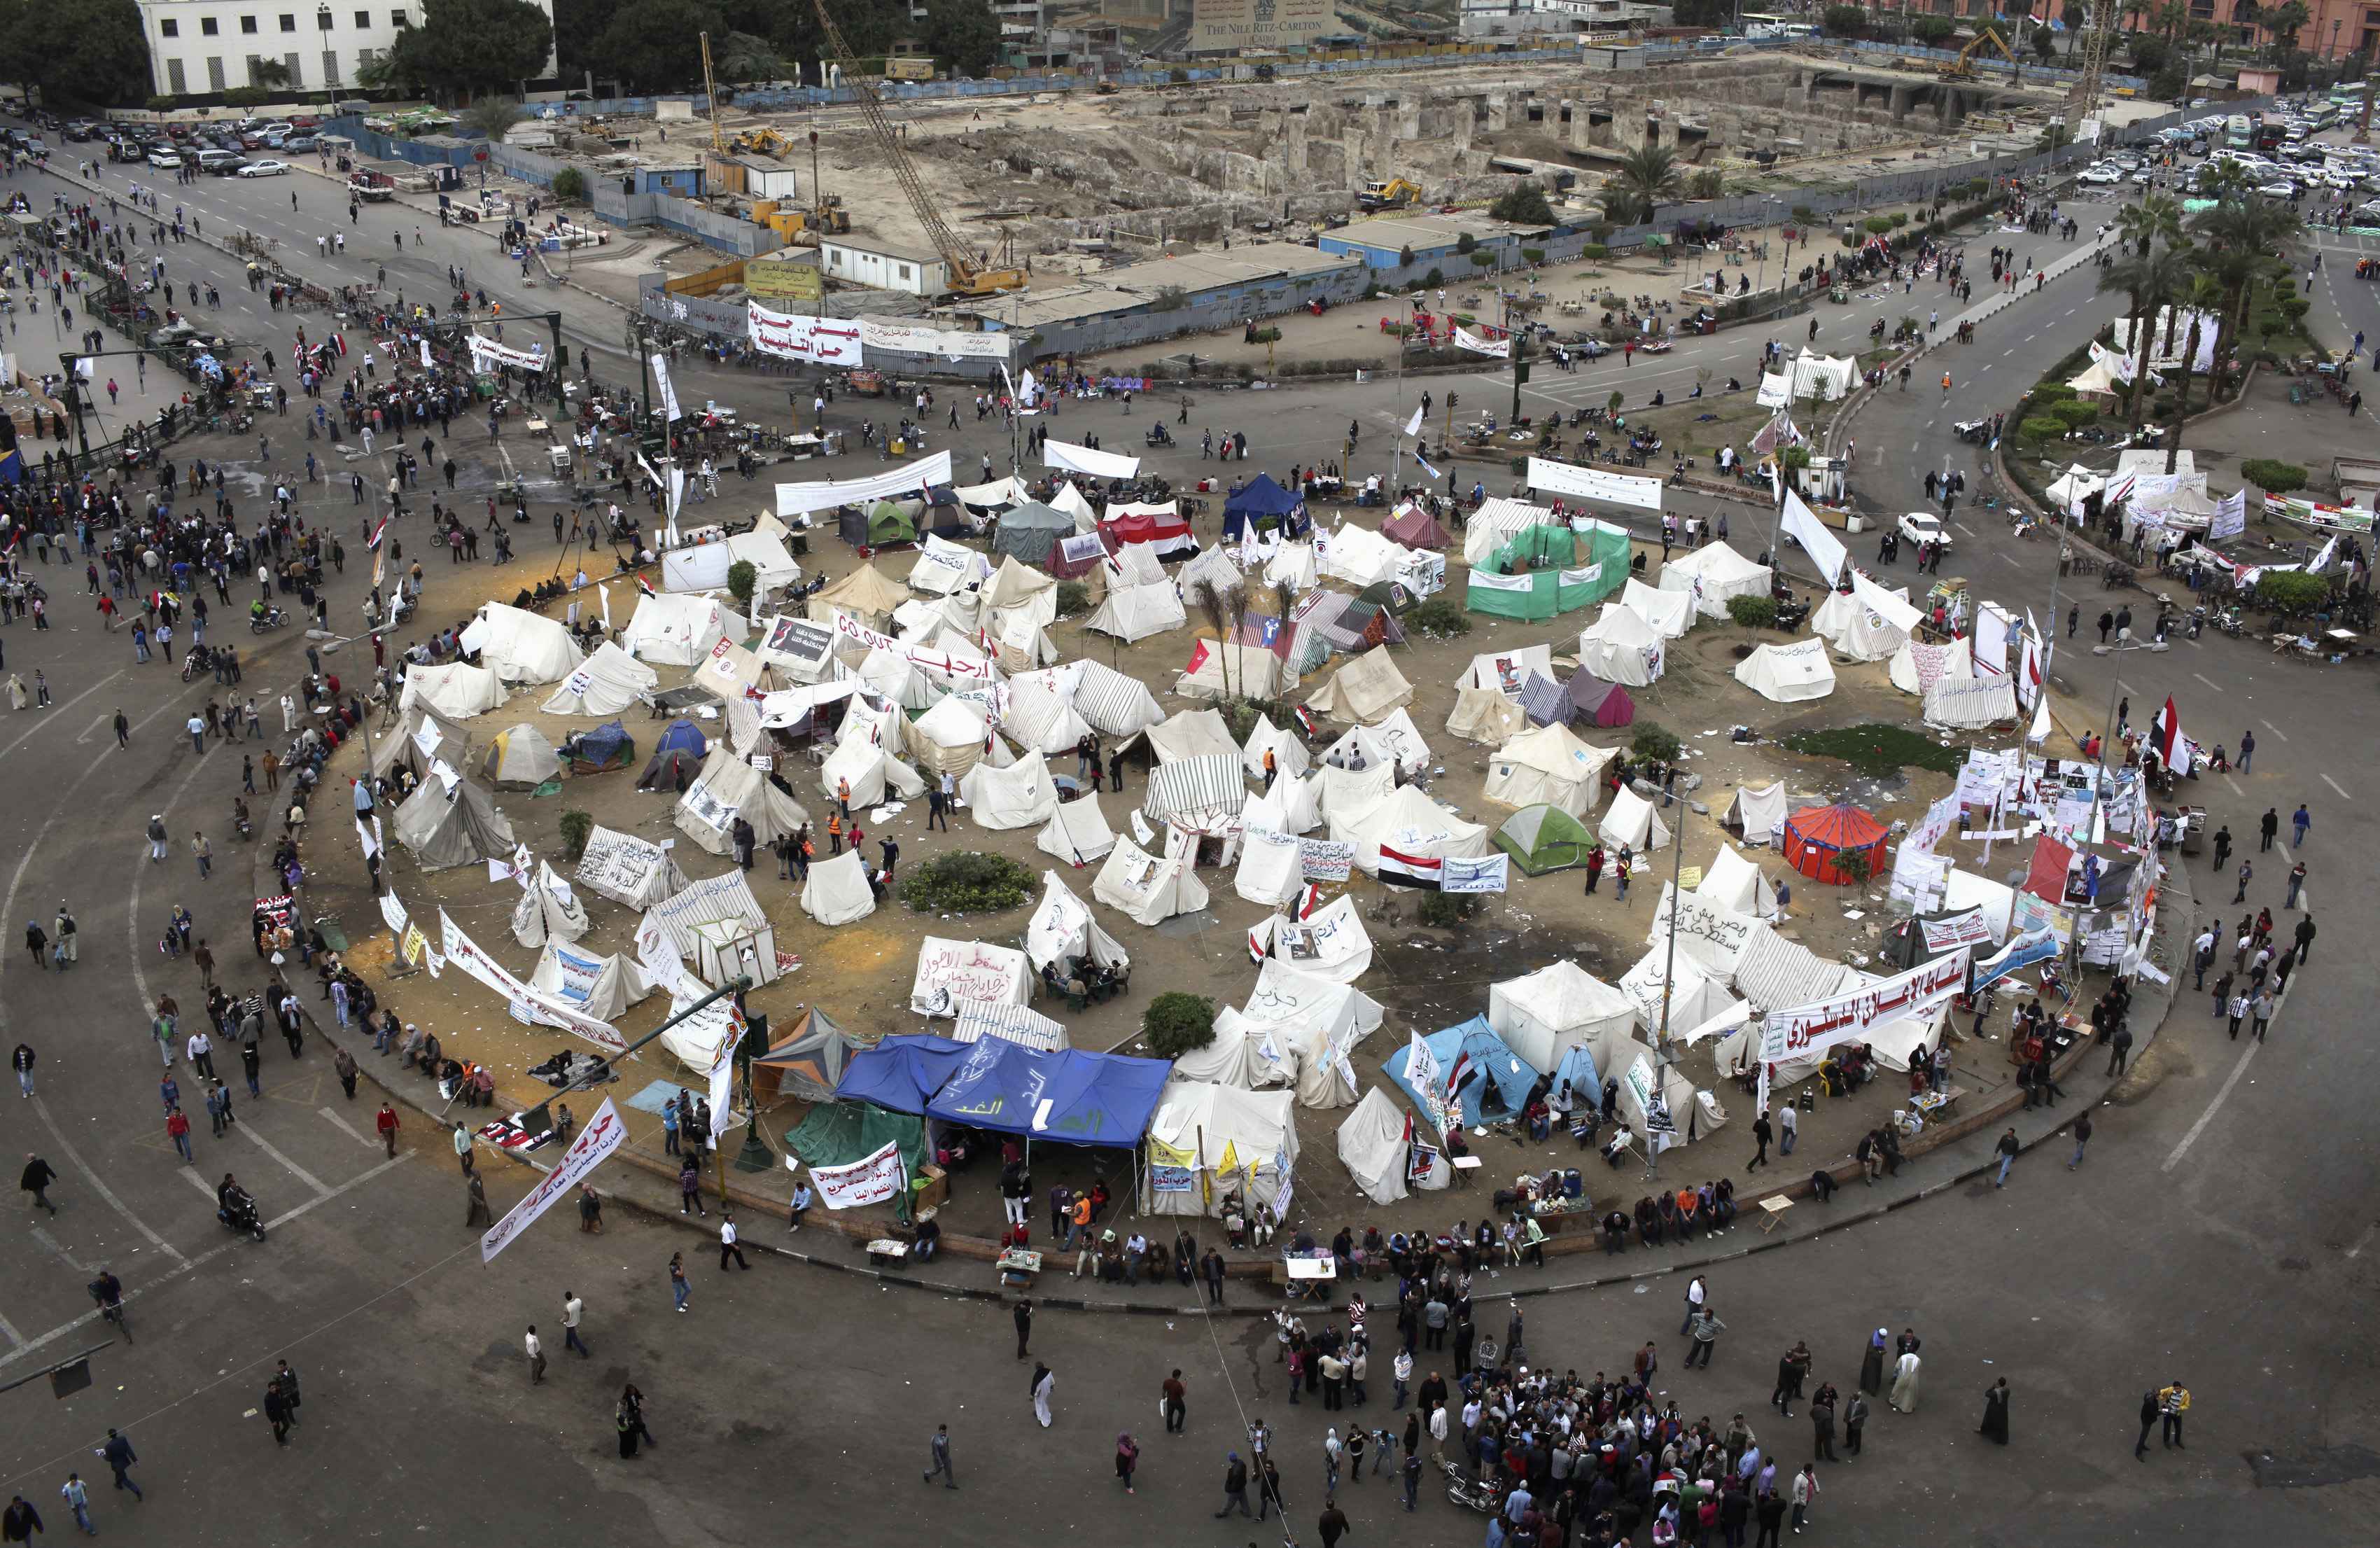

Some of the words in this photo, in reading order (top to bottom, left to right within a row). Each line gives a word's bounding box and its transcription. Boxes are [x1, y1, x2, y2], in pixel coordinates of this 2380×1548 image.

[1205, 25, 1226, 35] THE
[1228, 22, 1250, 34] NILE
[1254, 21, 1322, 33] RITZ-CARLTON
[749, 305, 794, 329] حرية
[808, 316, 860, 342] عيش
[758, 328, 814, 353] التأسيسية
[816, 341, 843, 358] حل
[839, 614, 859, 638] GO
[863, 630, 892, 653] OUT
[1445, 879, 1505, 891] الدستور
[1693, 907, 1714, 922] مش
[1714, 919, 1748, 938] مصر
[1704, 926, 1741, 954] يسقط
[920, 947, 961, 982] الاخوان
[967, 951, 1004, 972] يسقط
[1924, 956, 1968, 996] إسقاط
[1256, 987, 1297, 1007] حزب
[1862, 974, 1924, 1029] الإعلان
[954, 1096, 1003, 1115] الغد
[573, 1113, 613, 1155] حزب
[601, 1126, 622, 1150] شعارنا
[827, 1181, 846, 1196] سريع
[1151, 1174, 1172, 1185] الثورة
[870, 1183, 893, 1198] انضموا
